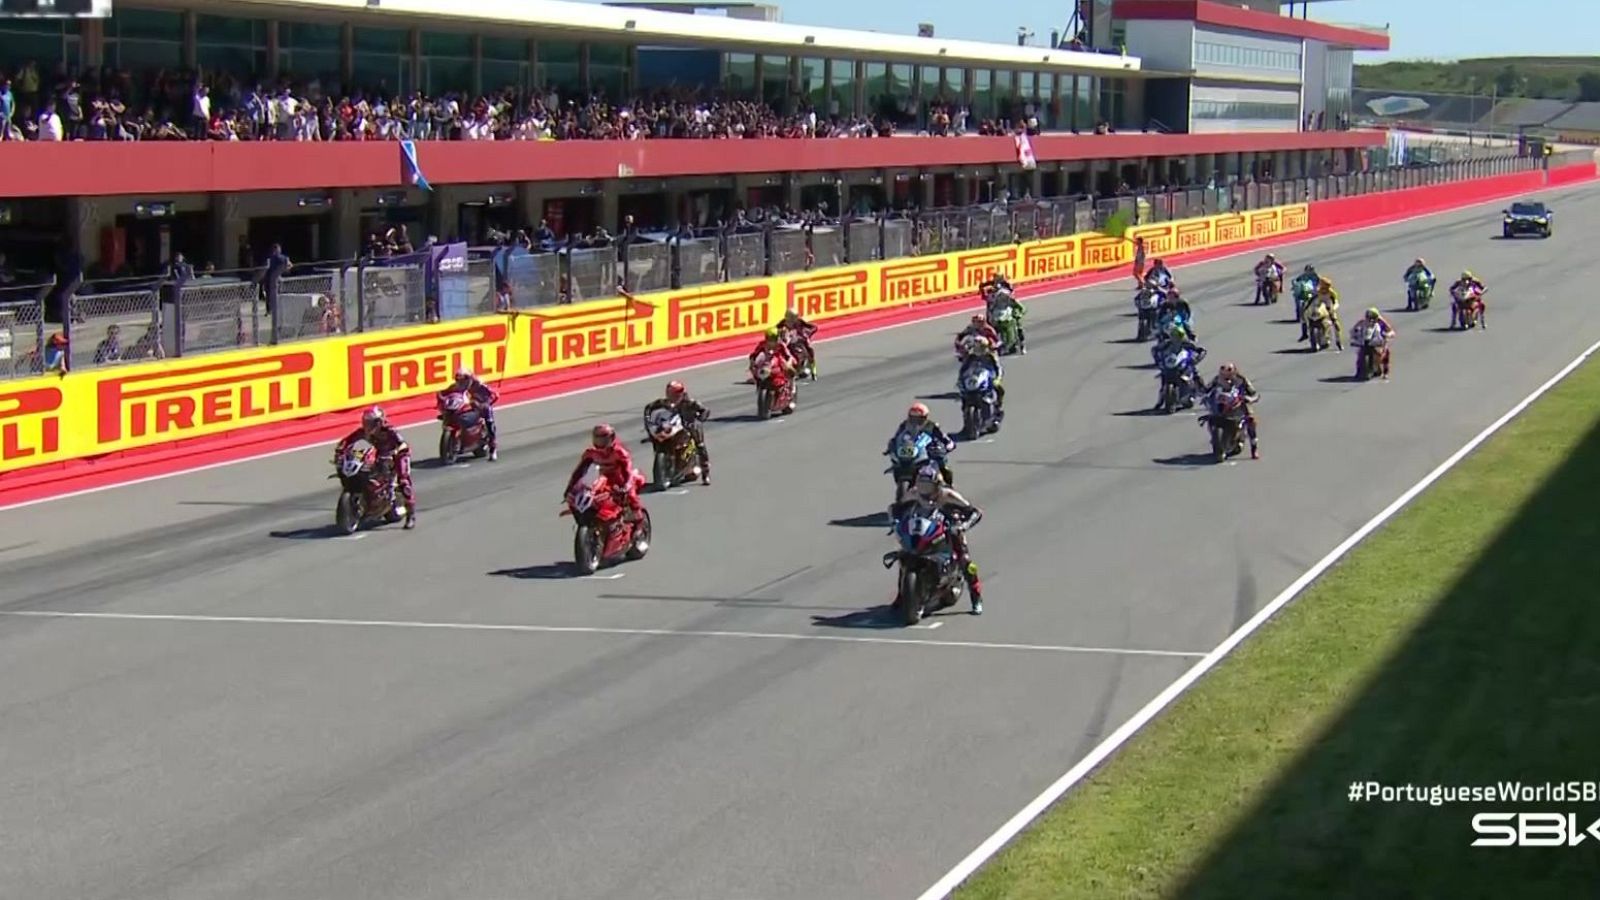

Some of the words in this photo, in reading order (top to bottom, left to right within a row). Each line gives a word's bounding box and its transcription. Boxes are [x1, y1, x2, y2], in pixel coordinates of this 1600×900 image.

[1081, 235, 1126, 265] PIRELLI
[1176, 221, 1210, 249] PIRELLI
[1215, 216, 1246, 242] PIRELLI
[881, 259, 948, 301] PIRELLI
[1025, 241, 1075, 276] PIRELLI
[667, 284, 770, 341] PIRELLI
[787, 270, 868, 317] PIRELLI
[530, 300, 654, 366] PIRELLI
[347, 323, 507, 399] PIRELLI
[97, 351, 314, 443] PIRELLI
